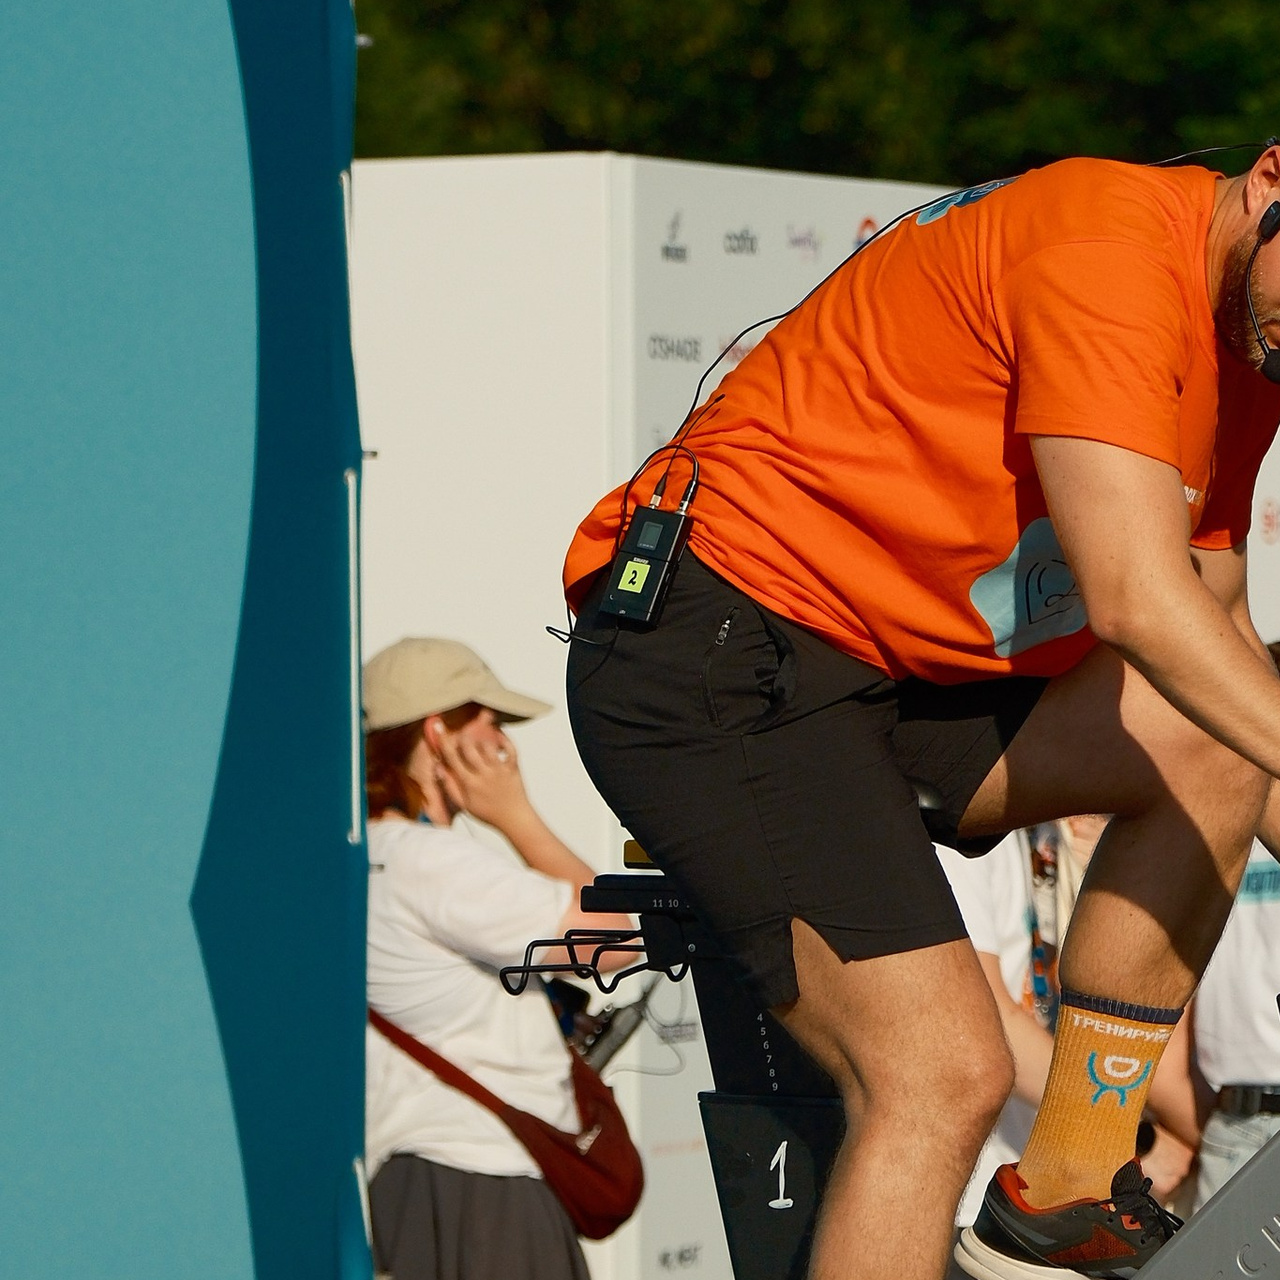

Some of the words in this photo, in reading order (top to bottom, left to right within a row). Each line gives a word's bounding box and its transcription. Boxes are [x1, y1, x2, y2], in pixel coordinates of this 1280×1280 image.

[628, 570, 638, 585] 2
[653, 899, 663, 908] 11
[668, 899, 679, 908] 10
[757, 1013, 763, 1021] 4
[760, 1027, 766, 1036] 5
[763, 1041, 769, 1050] 6
[766, 1055, 772, 1063] 7
[769, 1069, 775, 1077] 8
[772, 1082, 778, 1091] 9
[768, 1140, 793, 1209] 1
